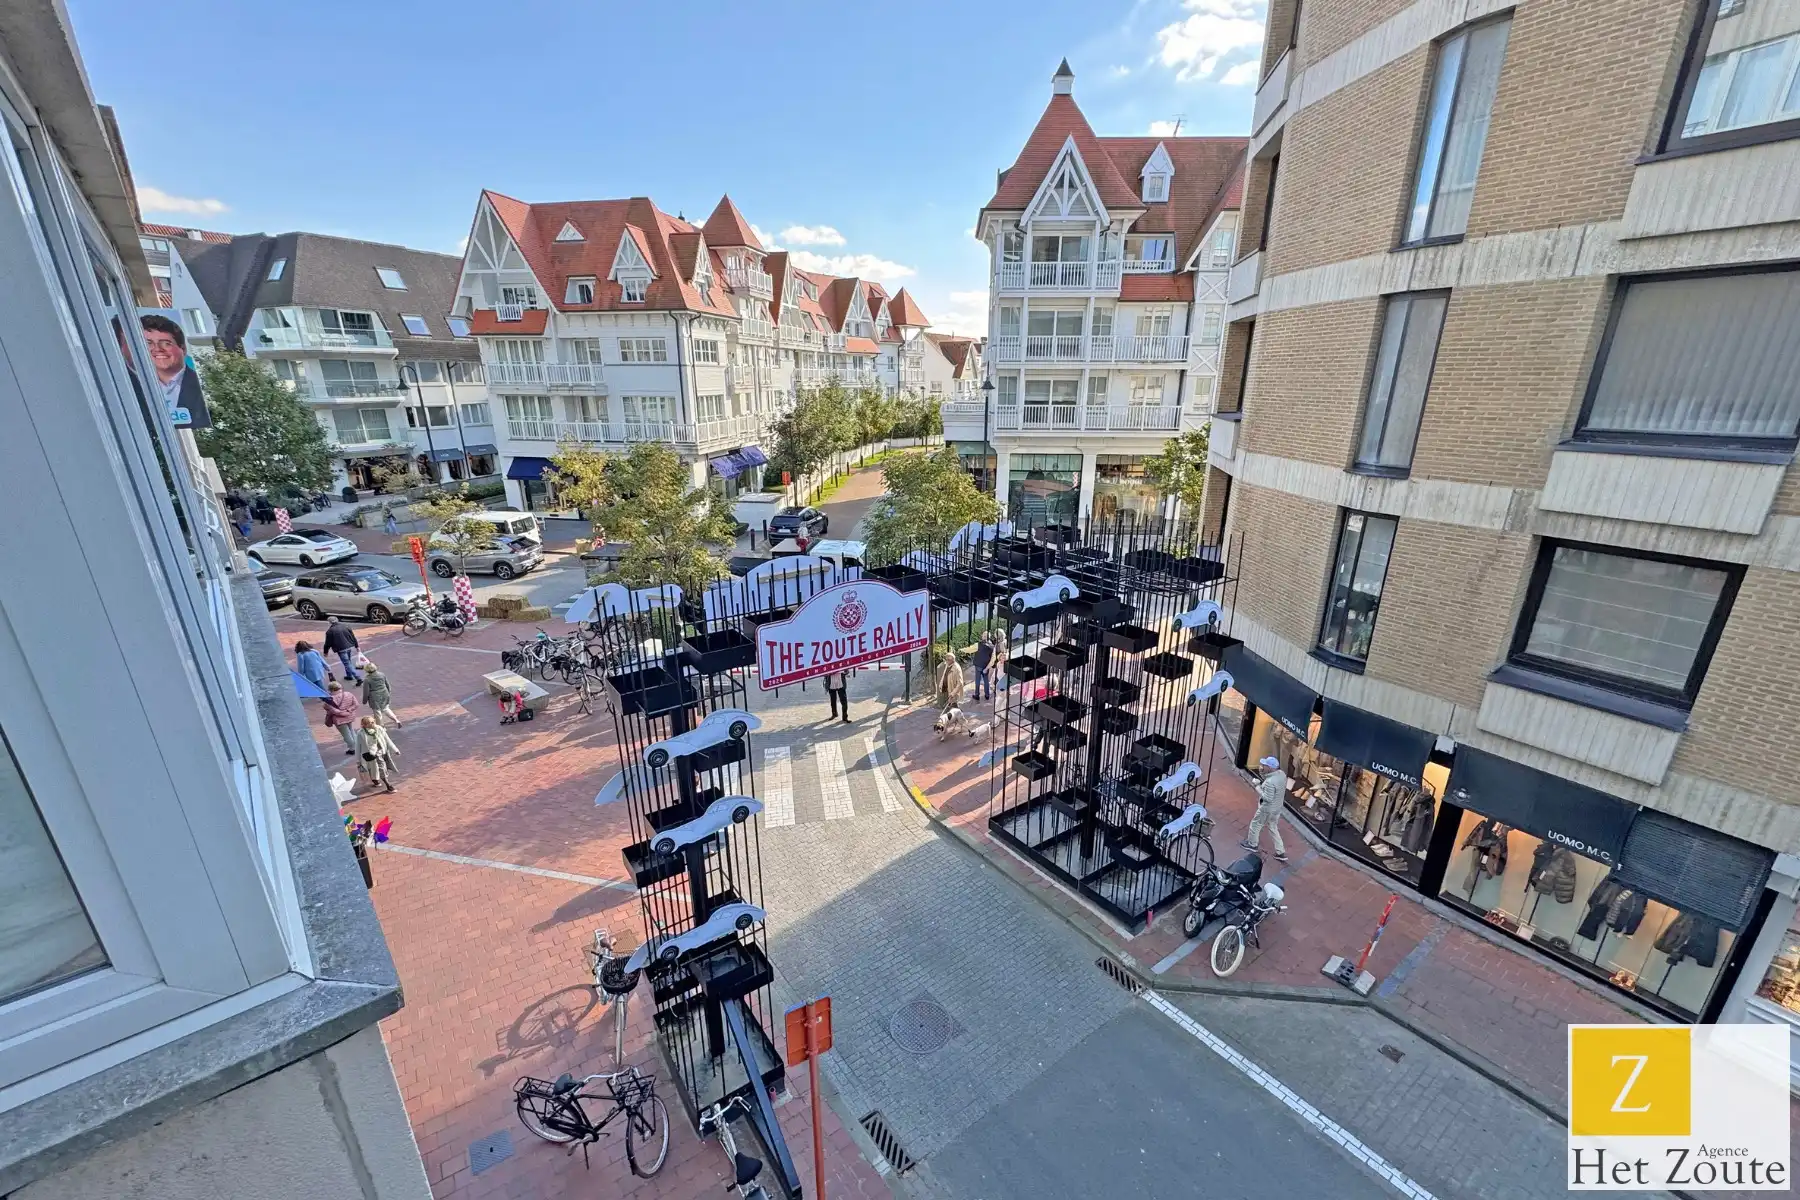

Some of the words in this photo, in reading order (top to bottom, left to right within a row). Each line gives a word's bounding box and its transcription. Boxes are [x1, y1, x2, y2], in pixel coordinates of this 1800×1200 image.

[765, 640, 805, 677] THE
[811, 632, 867, 666] ZOUTE
[873, 604, 924, 650] RALLY
[1281, 716, 1296, 731] UOMO
[1371, 761, 1399, 778] UOMO
[1547, 829, 1585, 850] UOMO
[1587, 845, 1613, 862] M.C.
